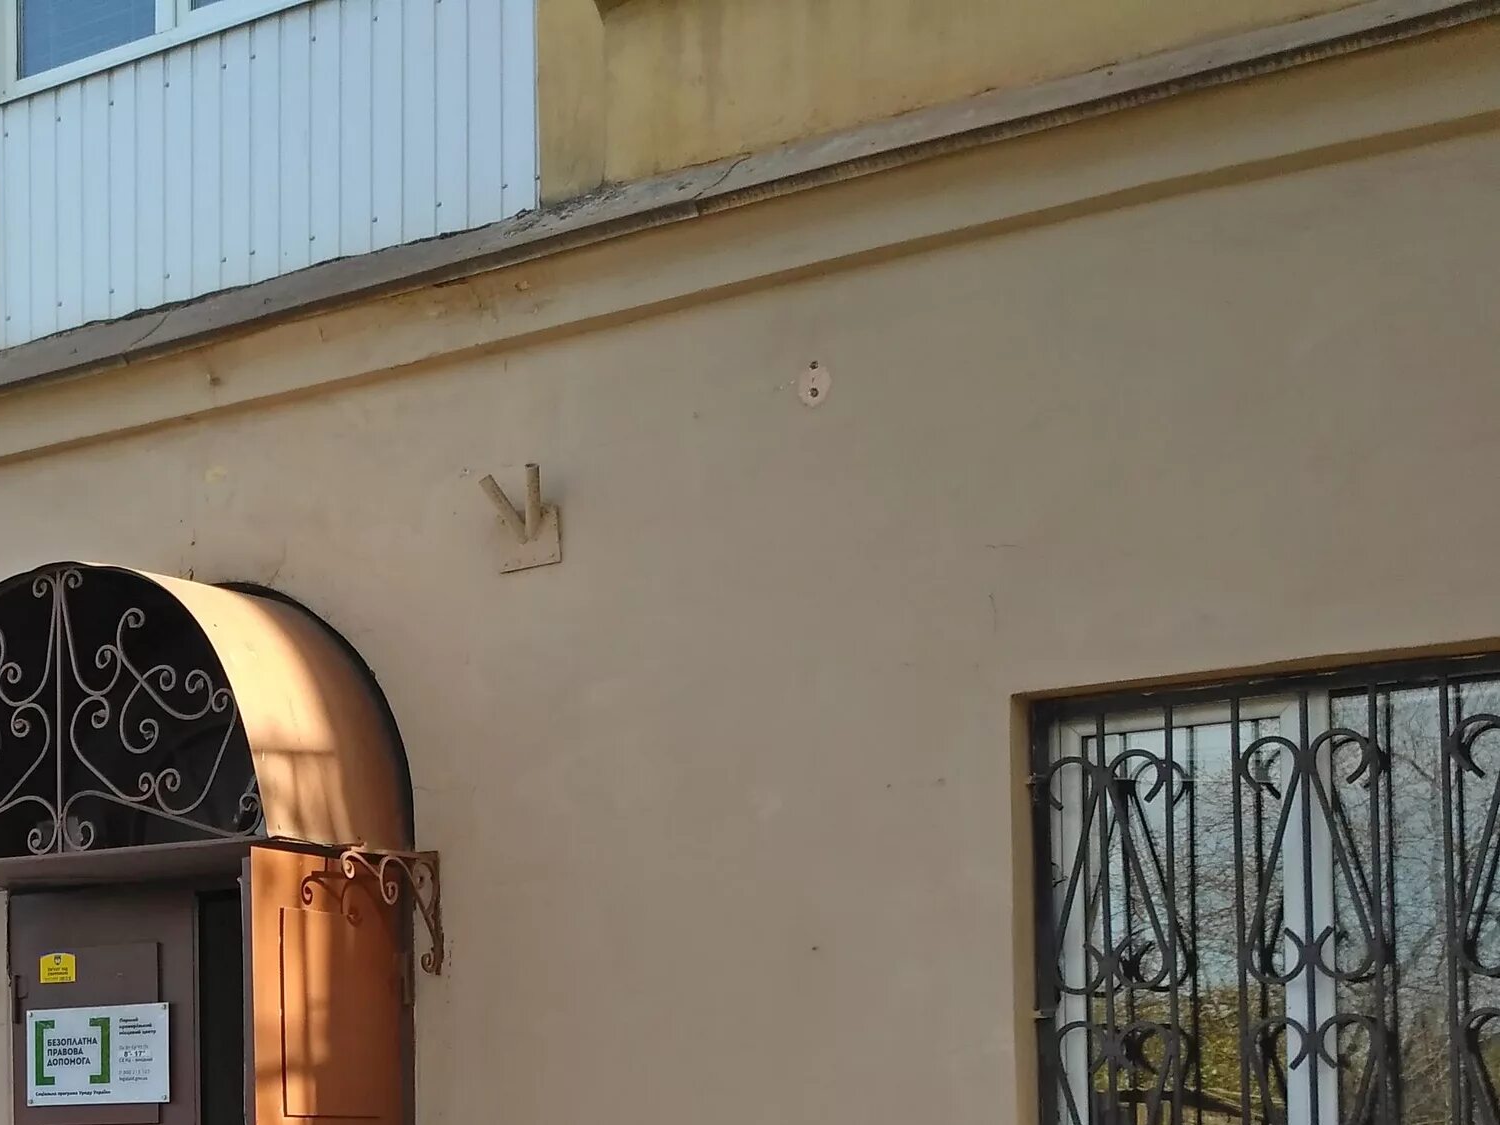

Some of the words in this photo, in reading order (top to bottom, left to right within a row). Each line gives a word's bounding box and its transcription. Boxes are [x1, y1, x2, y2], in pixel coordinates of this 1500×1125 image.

[47, 1037, 98, 1047] БЕЗОПЛАТНА
[47, 1047, 84, 1056] ПРАВОВА
[47, 1057, 91, 1067] ДОПОМОГА
